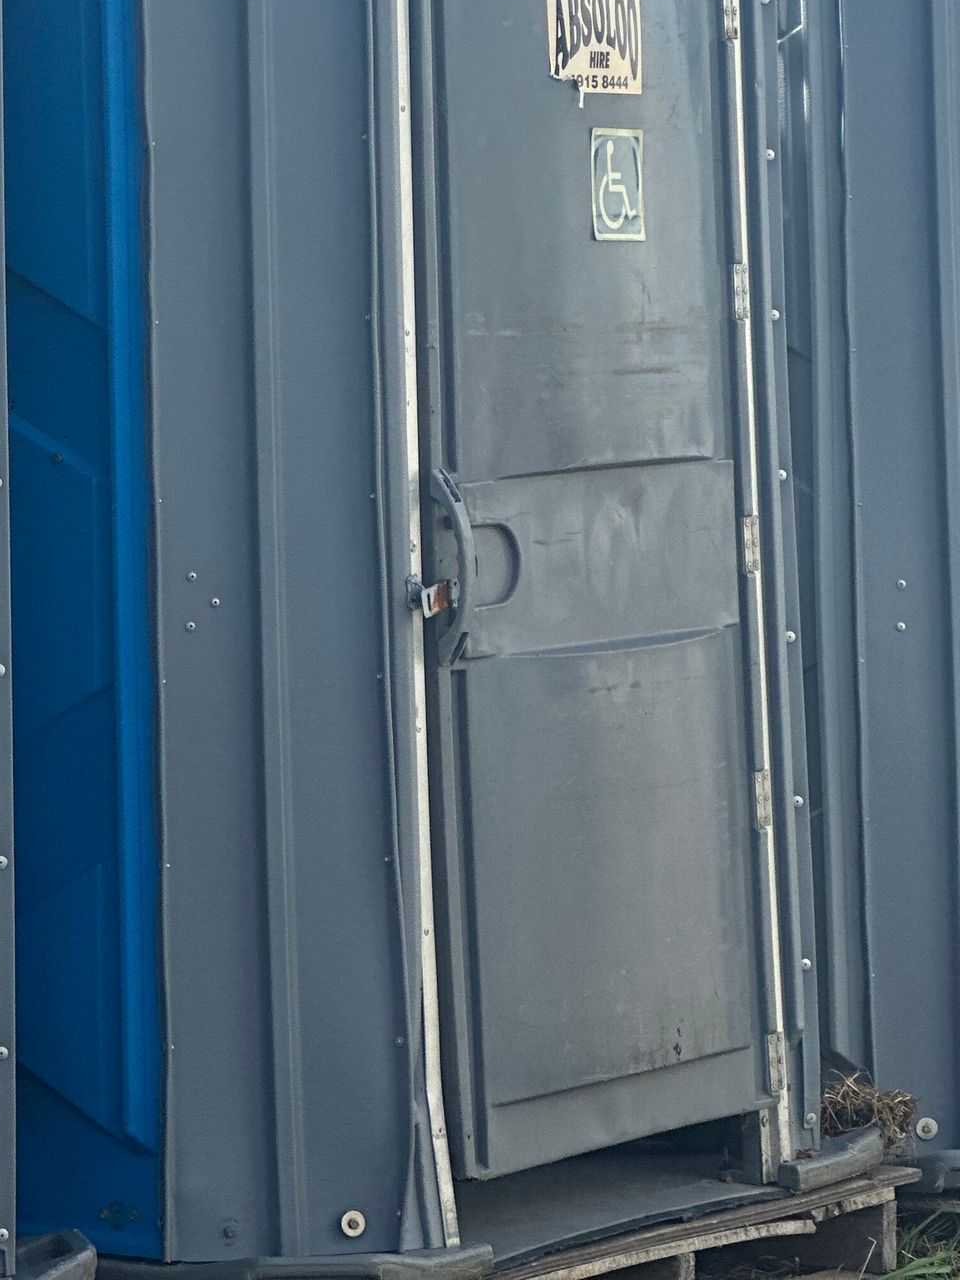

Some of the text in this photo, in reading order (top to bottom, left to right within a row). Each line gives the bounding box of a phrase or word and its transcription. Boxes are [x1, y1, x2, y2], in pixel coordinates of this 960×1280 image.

[589, 51, 610, 69] HIRE
[571, 74, 629, 90] 915 8444
